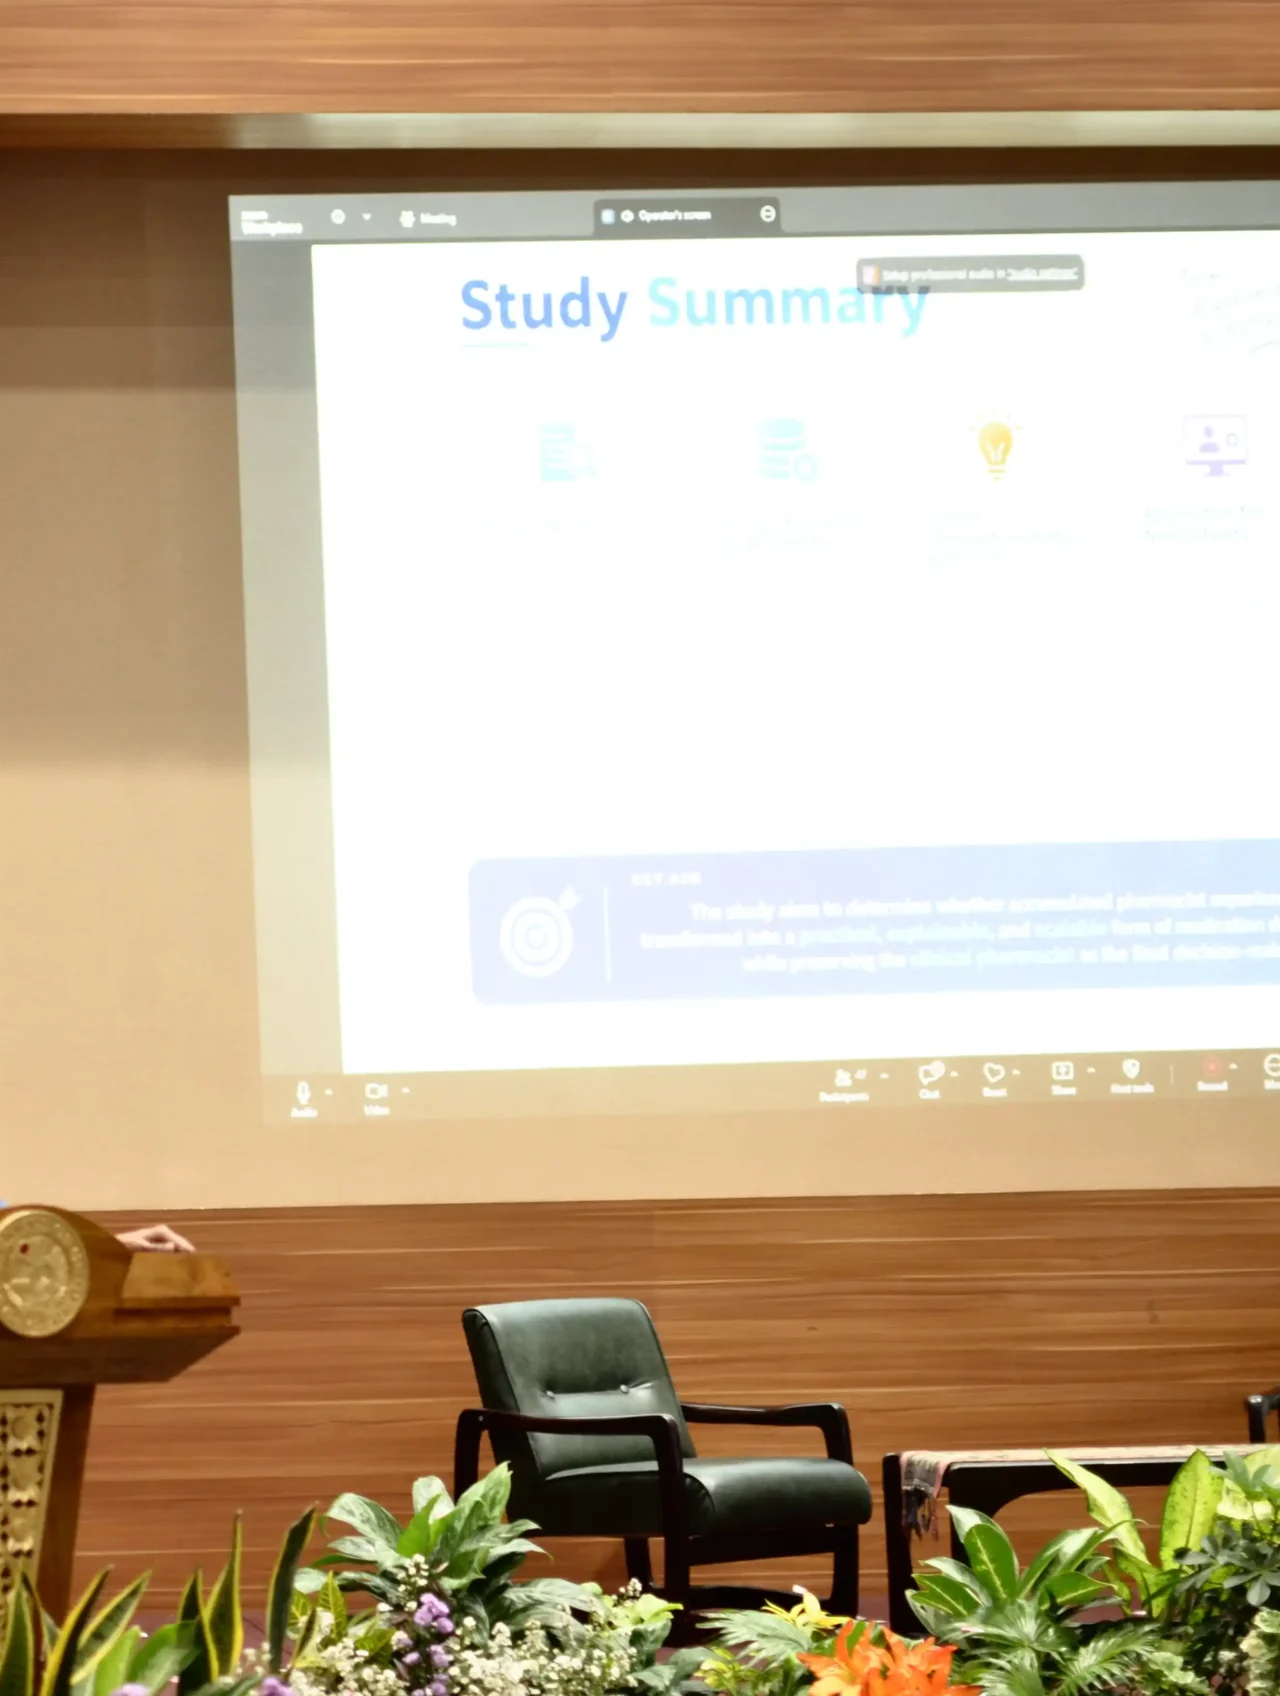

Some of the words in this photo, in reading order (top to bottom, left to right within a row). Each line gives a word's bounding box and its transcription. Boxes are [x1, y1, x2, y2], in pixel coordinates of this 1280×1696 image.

[461, 276, 628, 343] Study
[648, 277, 931, 337] Summary
[691, 904, 722, 920] The
